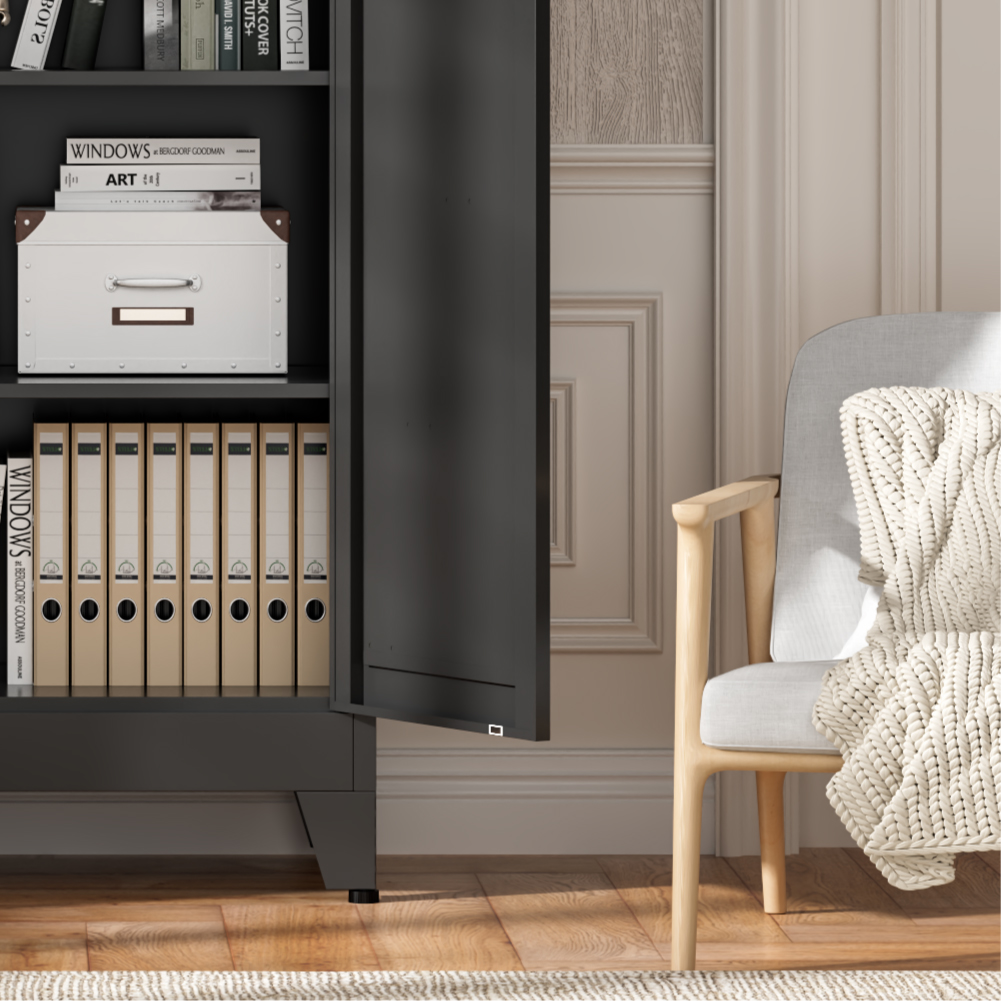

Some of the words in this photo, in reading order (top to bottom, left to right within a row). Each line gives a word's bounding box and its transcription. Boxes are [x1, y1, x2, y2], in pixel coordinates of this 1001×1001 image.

[245, 0, 256, 37] TUTS+
[257, 10, 269, 56] COVER
[156, 23, 165, 62] MEDBURY
[224, 26, 233, 50] SMITH
[70, 143, 151, 159] WINDOWS
[159, 147, 191, 156] BERGDORF
[192, 147, 225, 156] GOODMAN
[105, 173, 137, 186] ART
[9, 465, 31, 558] WINDOWS
[14, 568, 25, 605] BERGDORF
[15, 606, 25, 644] GOODMAN
